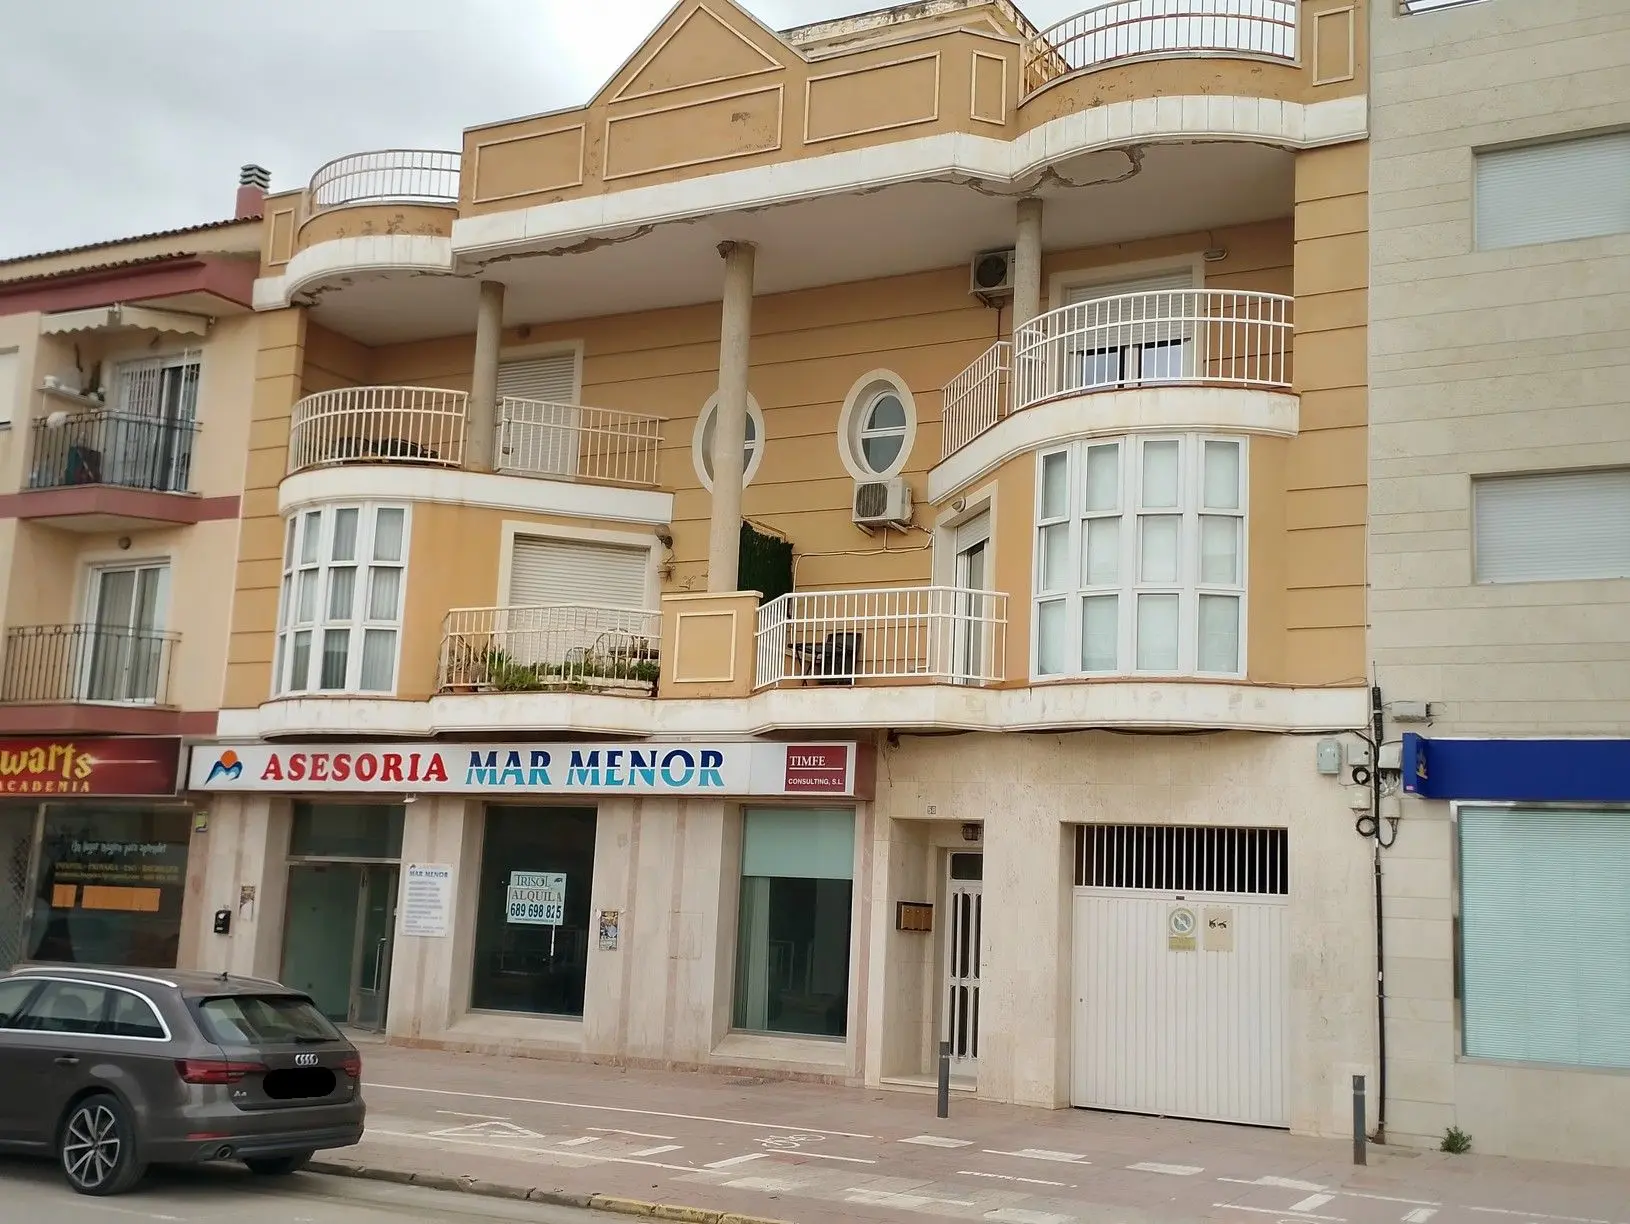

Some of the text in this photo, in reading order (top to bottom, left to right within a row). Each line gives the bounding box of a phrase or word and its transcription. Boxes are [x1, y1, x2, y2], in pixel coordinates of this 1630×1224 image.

[260, 749, 725, 787] ASESORIA MAR MENOR
[789, 755, 826, 767] TIMFE
[788, 778, 831, 786] CONSULTING,
[512, 889, 562, 903] ALQUILA
[510, 902, 562, 919] 689 698 825
